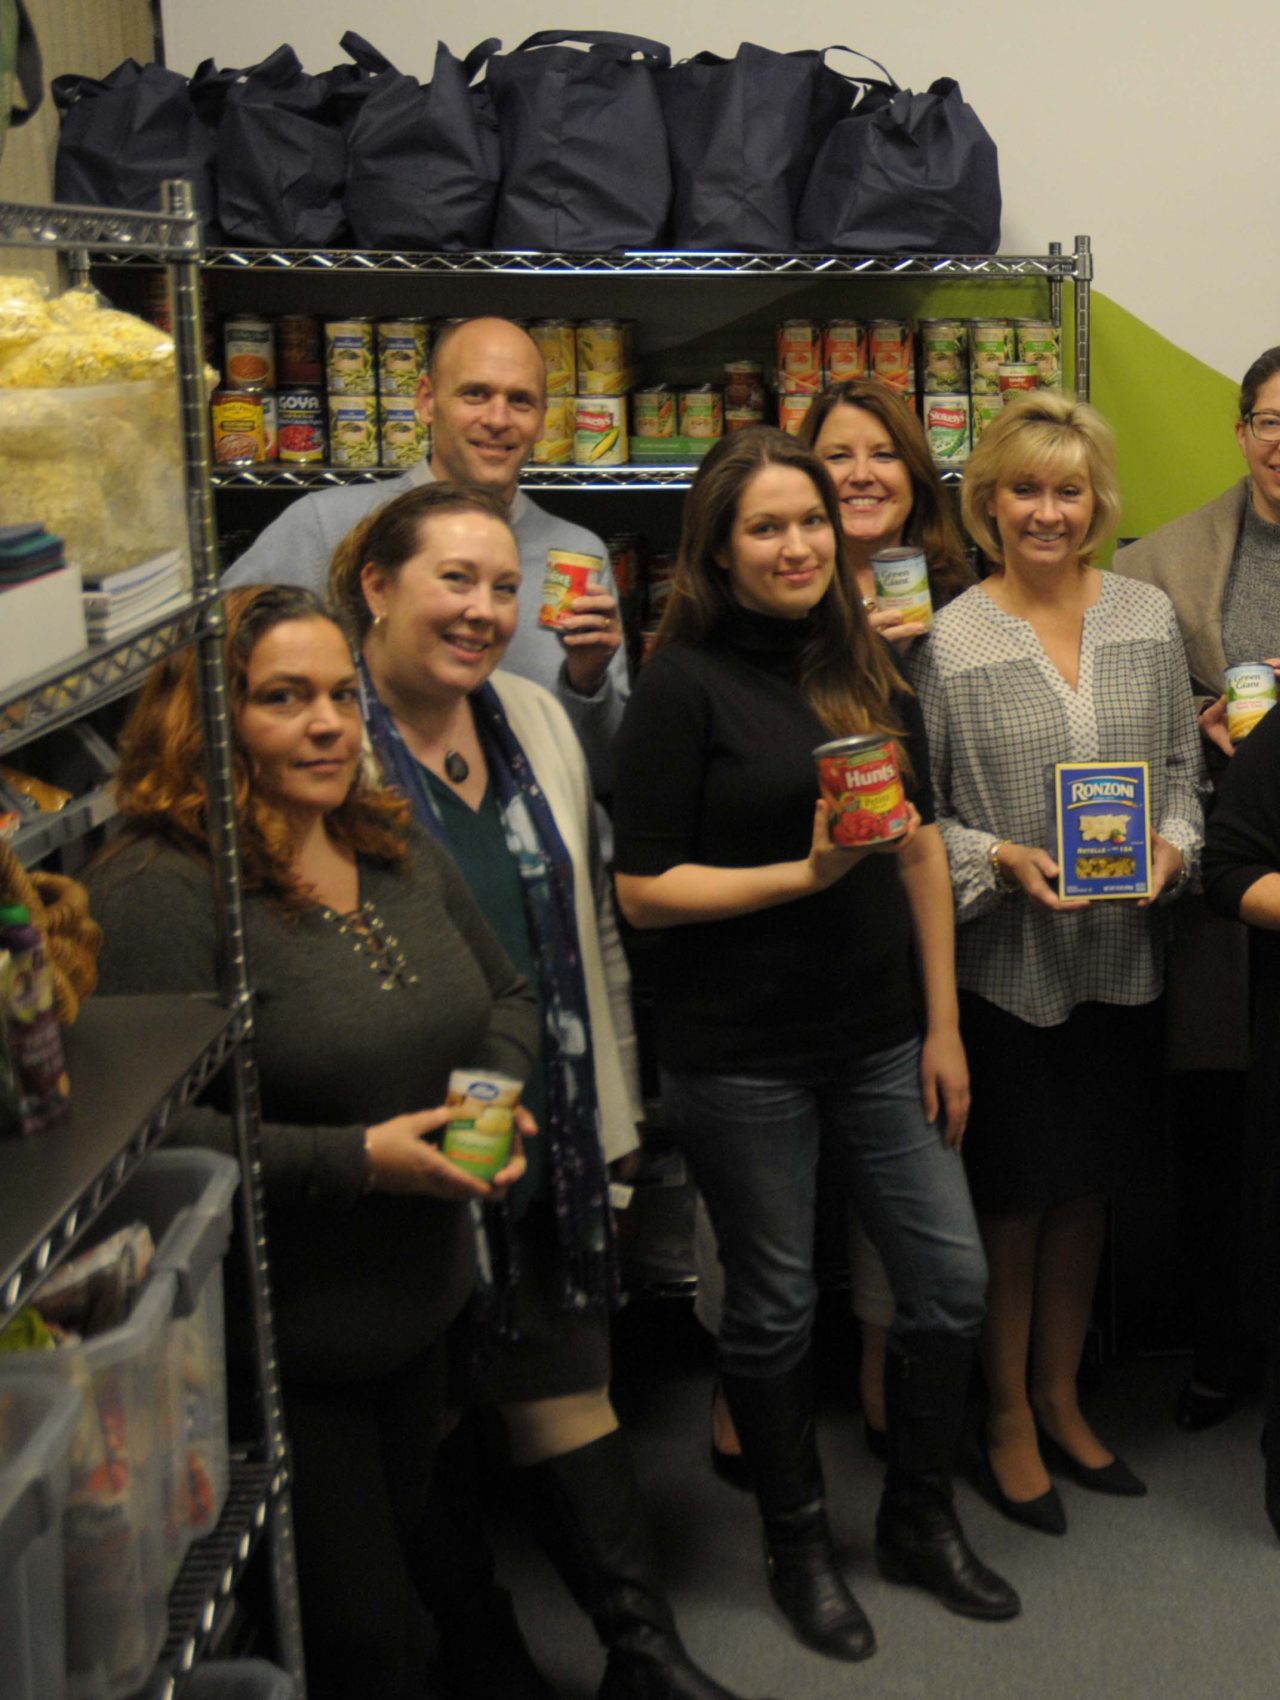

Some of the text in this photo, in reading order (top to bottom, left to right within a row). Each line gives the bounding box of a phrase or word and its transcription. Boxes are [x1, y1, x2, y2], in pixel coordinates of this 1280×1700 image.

[279, 395, 320, 410] GOYA
[881, 569, 910, 578] Green
[886, 577, 910, 587] Giant
[1235, 674, 1261, 682] Green
[1235, 681, 1260, 689] Giant
[1071, 782, 1135, 803] RONZONI
